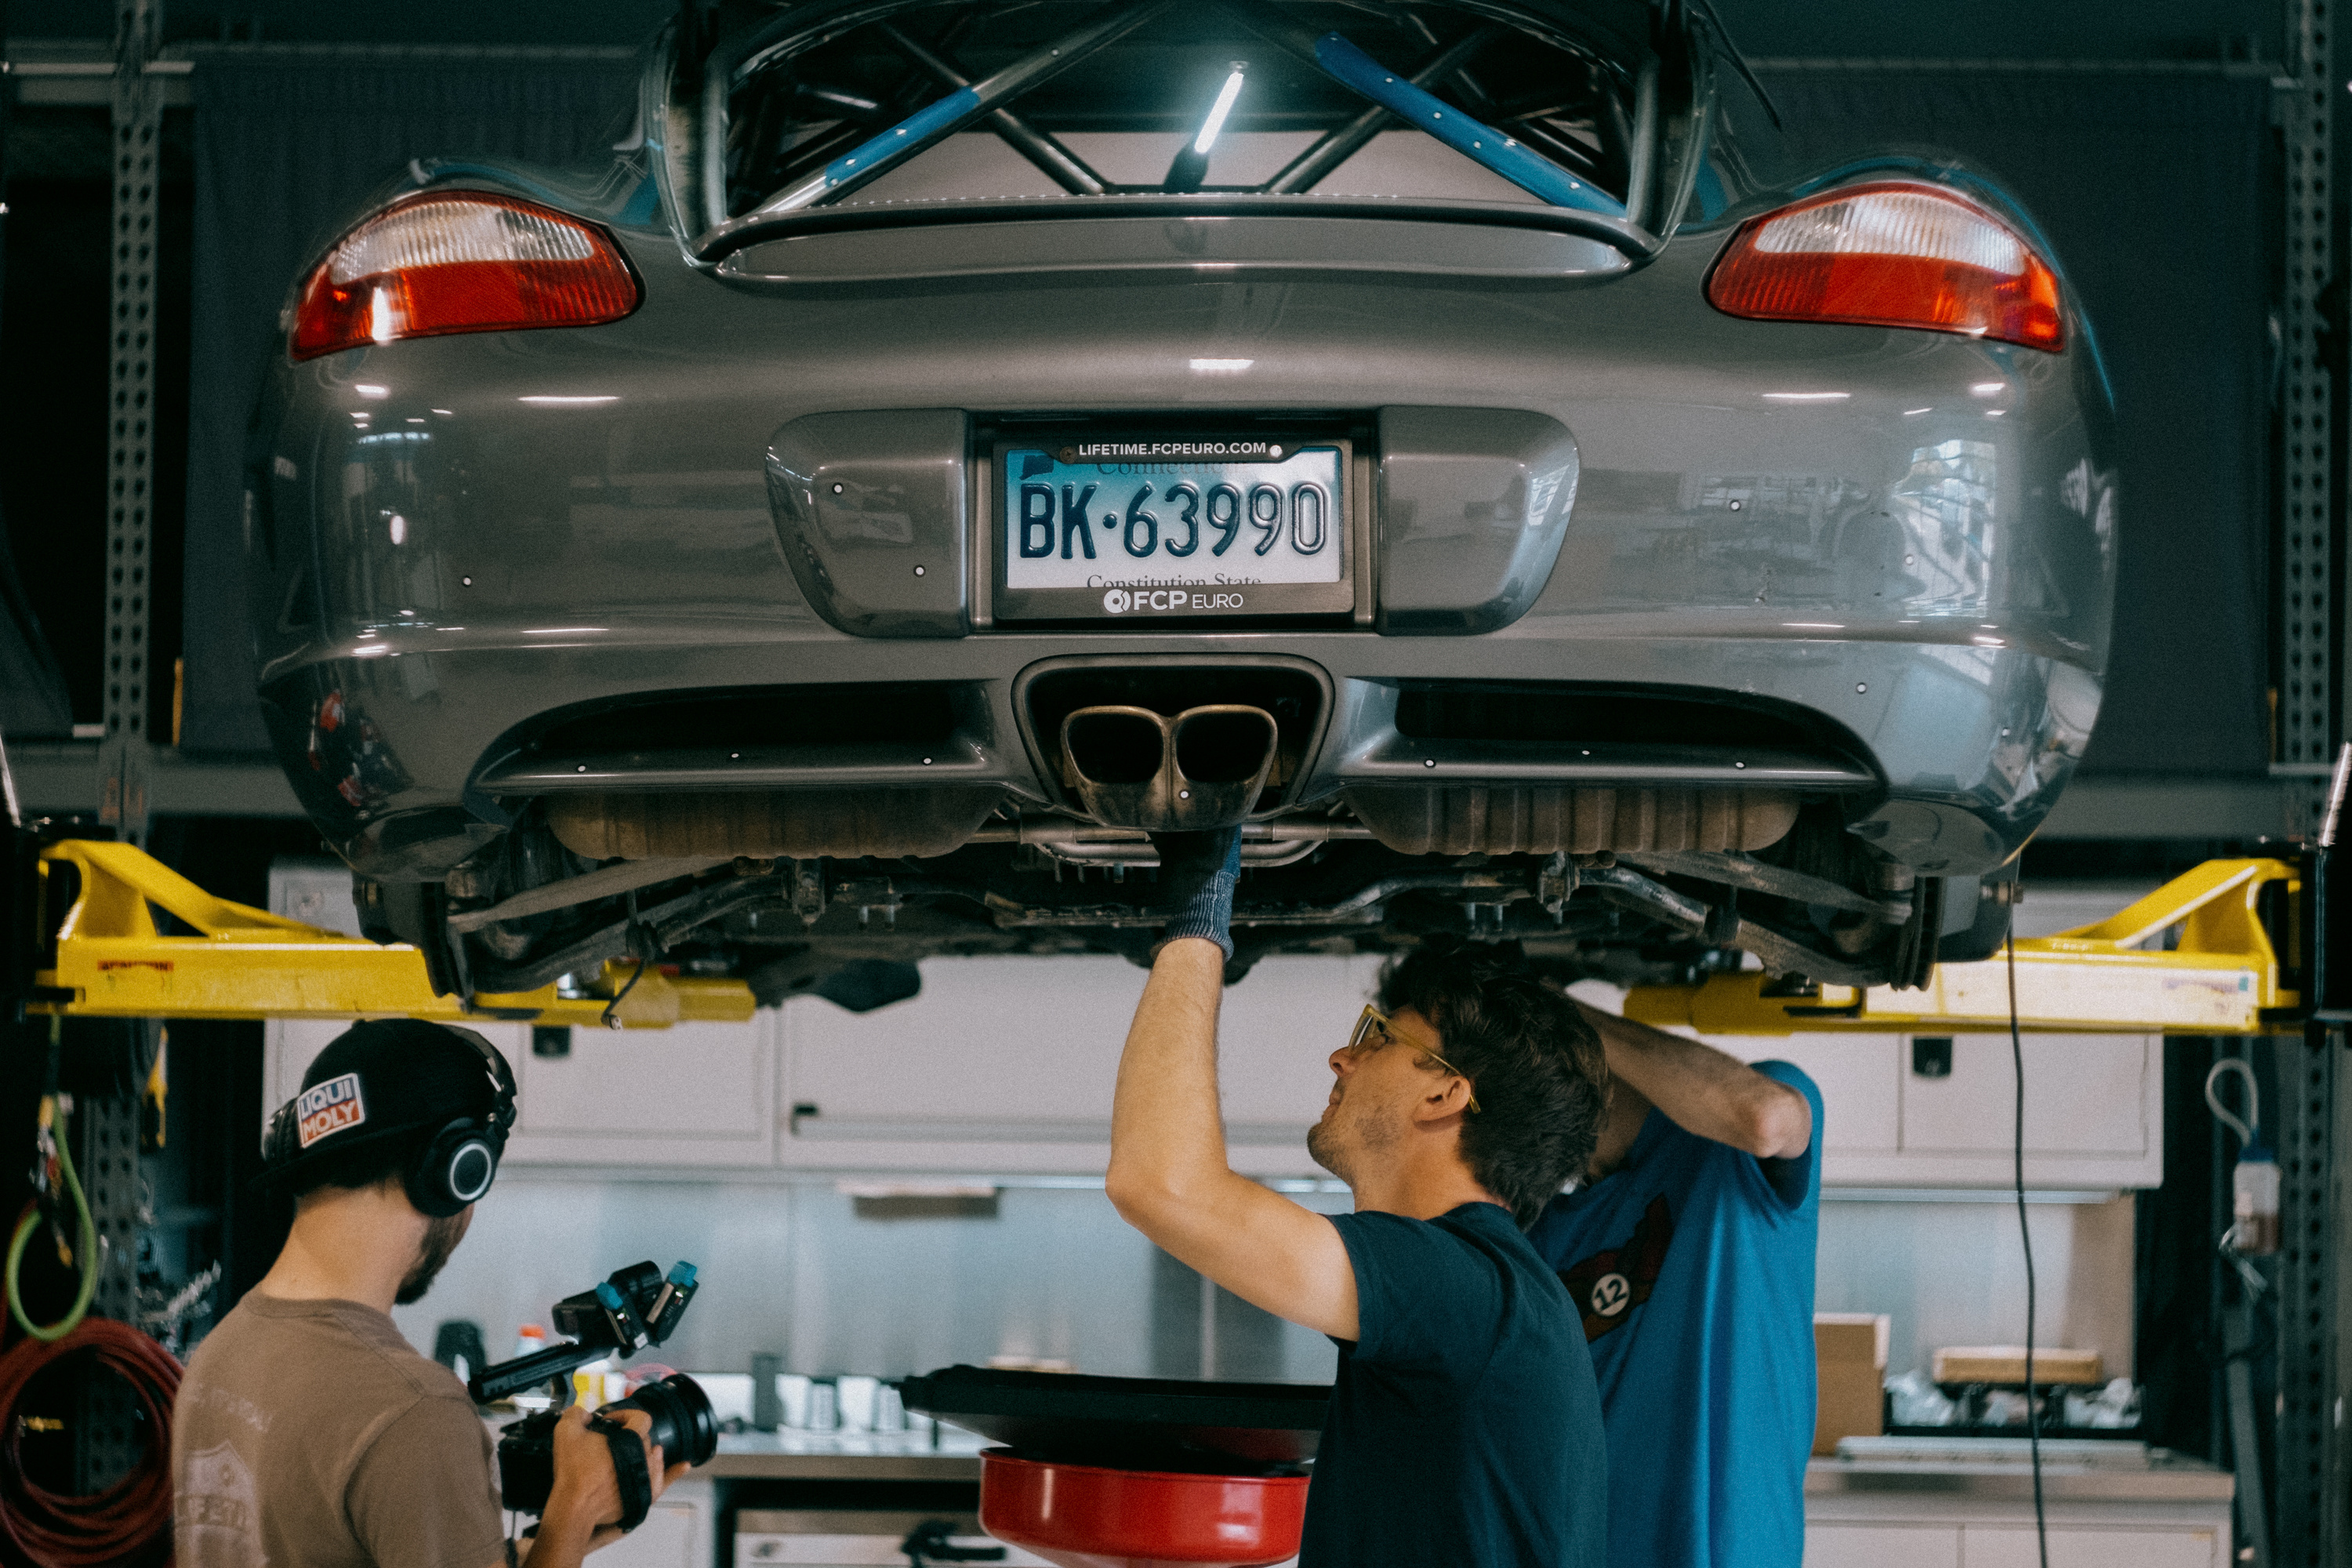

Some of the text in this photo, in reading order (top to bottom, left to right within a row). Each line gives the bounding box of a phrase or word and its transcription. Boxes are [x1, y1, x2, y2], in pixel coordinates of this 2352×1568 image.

[1079, 442, 1266, 456] LIFETIME.FCPEURO.COM
[1087, 573, 1261, 588] Constitution State
[1134, 590, 1244, 611] FCP EURO
[300, 1079, 353, 1120] LIQUI
[303, 1100, 356, 1142] MOLY
[1594, 1279, 1628, 1311] 12
